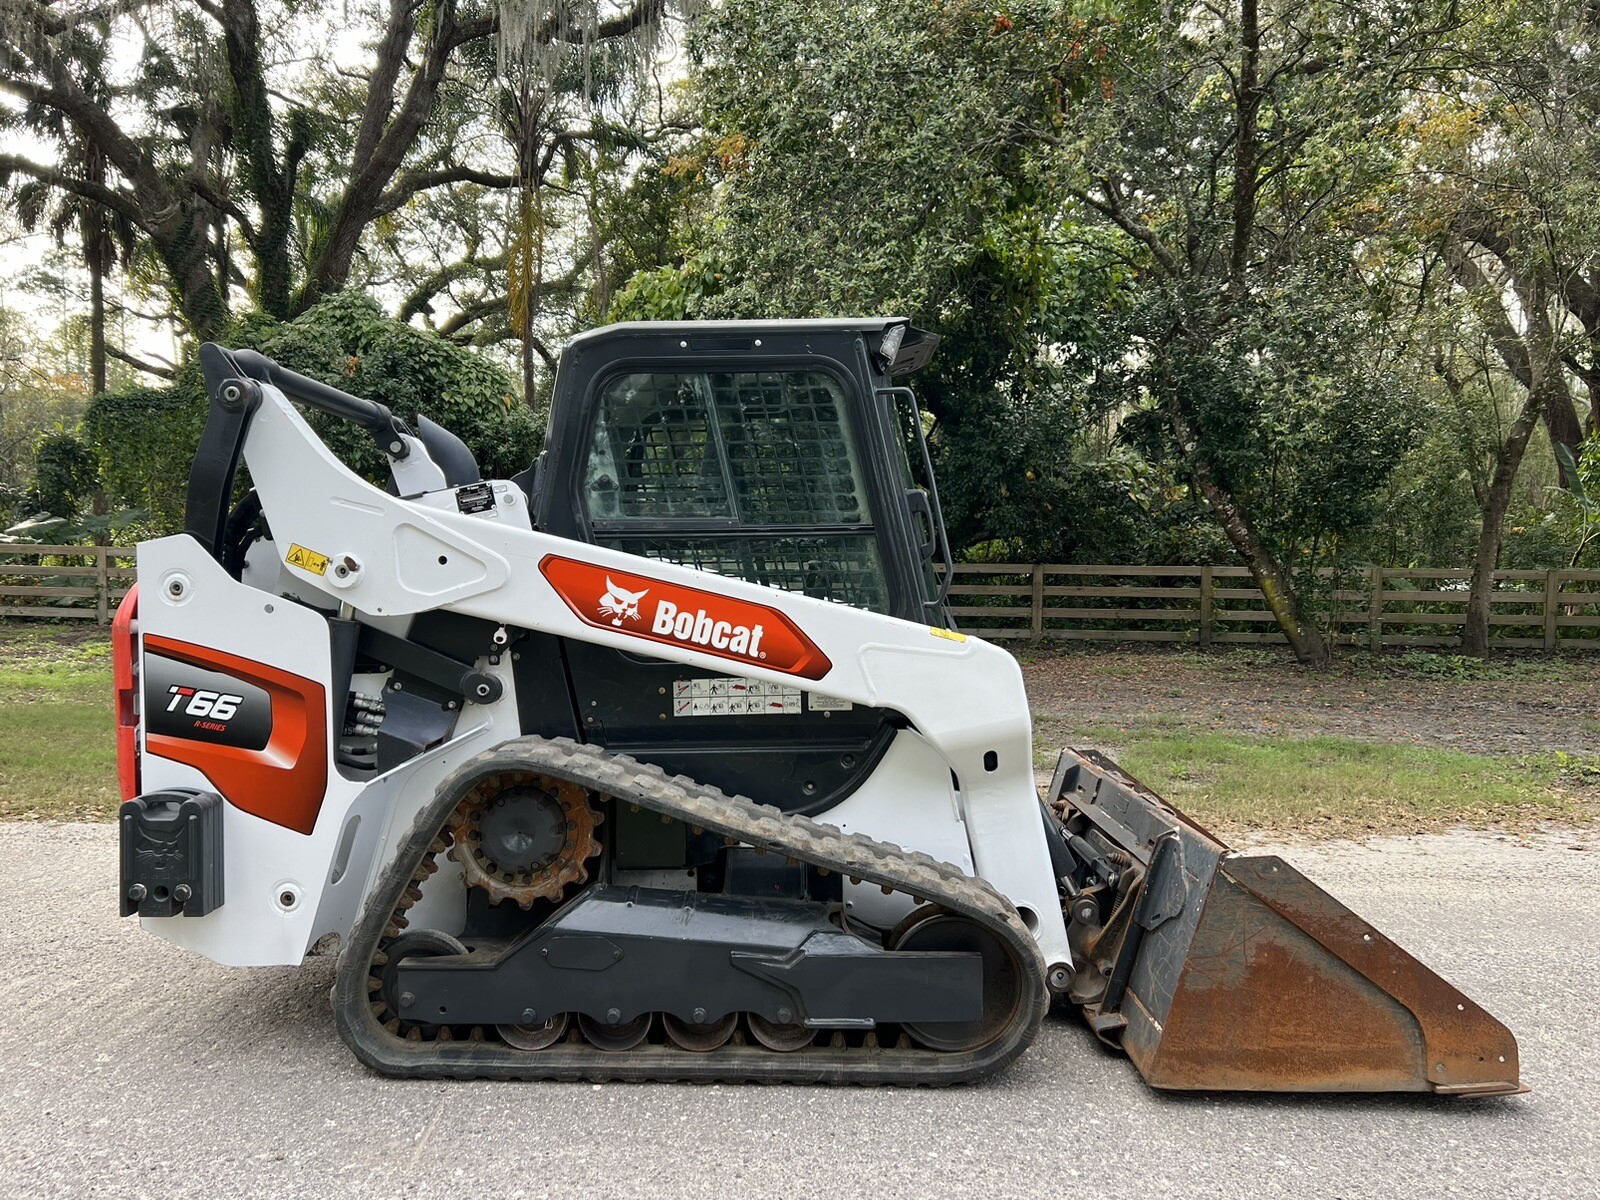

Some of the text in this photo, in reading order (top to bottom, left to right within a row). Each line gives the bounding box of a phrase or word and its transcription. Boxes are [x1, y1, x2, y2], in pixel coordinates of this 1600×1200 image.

[652, 600, 764, 658] Bobcat
[166, 685, 244, 721] T66
[194, 720, 226, 731] R-SERIES
